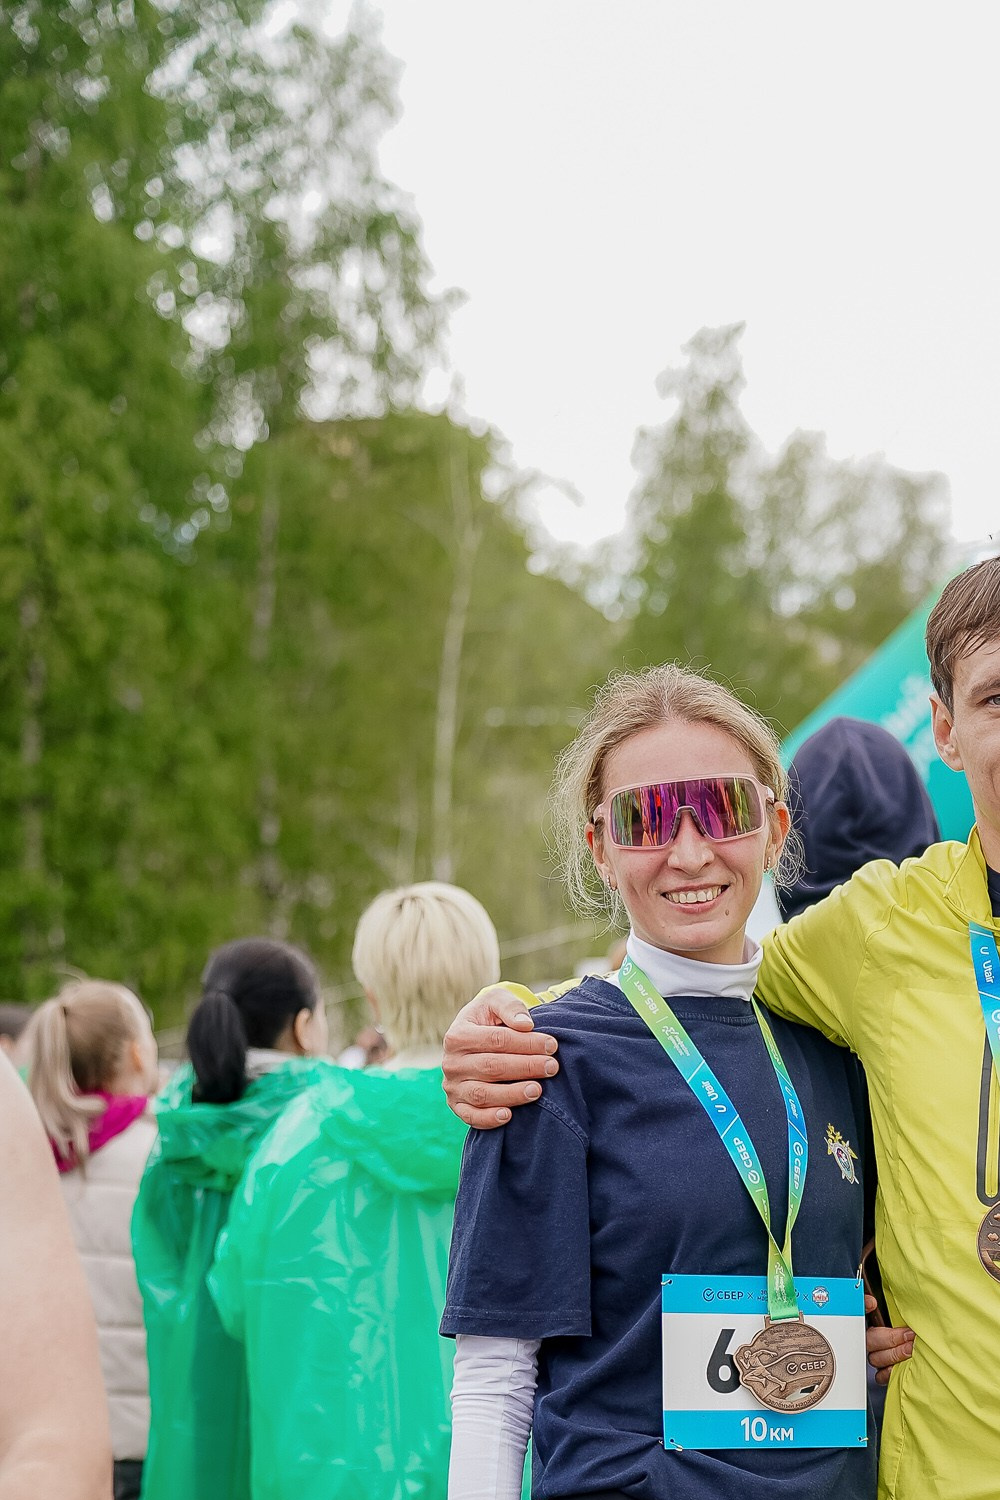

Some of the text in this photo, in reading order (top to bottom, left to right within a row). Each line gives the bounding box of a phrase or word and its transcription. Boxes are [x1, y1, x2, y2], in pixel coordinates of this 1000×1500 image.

[982, 960, 994, 983] Utair
[633, 980, 660, 1015] 185 лет
[701, 1080, 719, 1101] Utair
[732, 1137, 753, 1168] СБЕР
[793, 1157, 802, 1190] СБЕР
[717, 1290, 744, 1300] СБЕР
[800, 1360, 827, 1371] СБЕР
